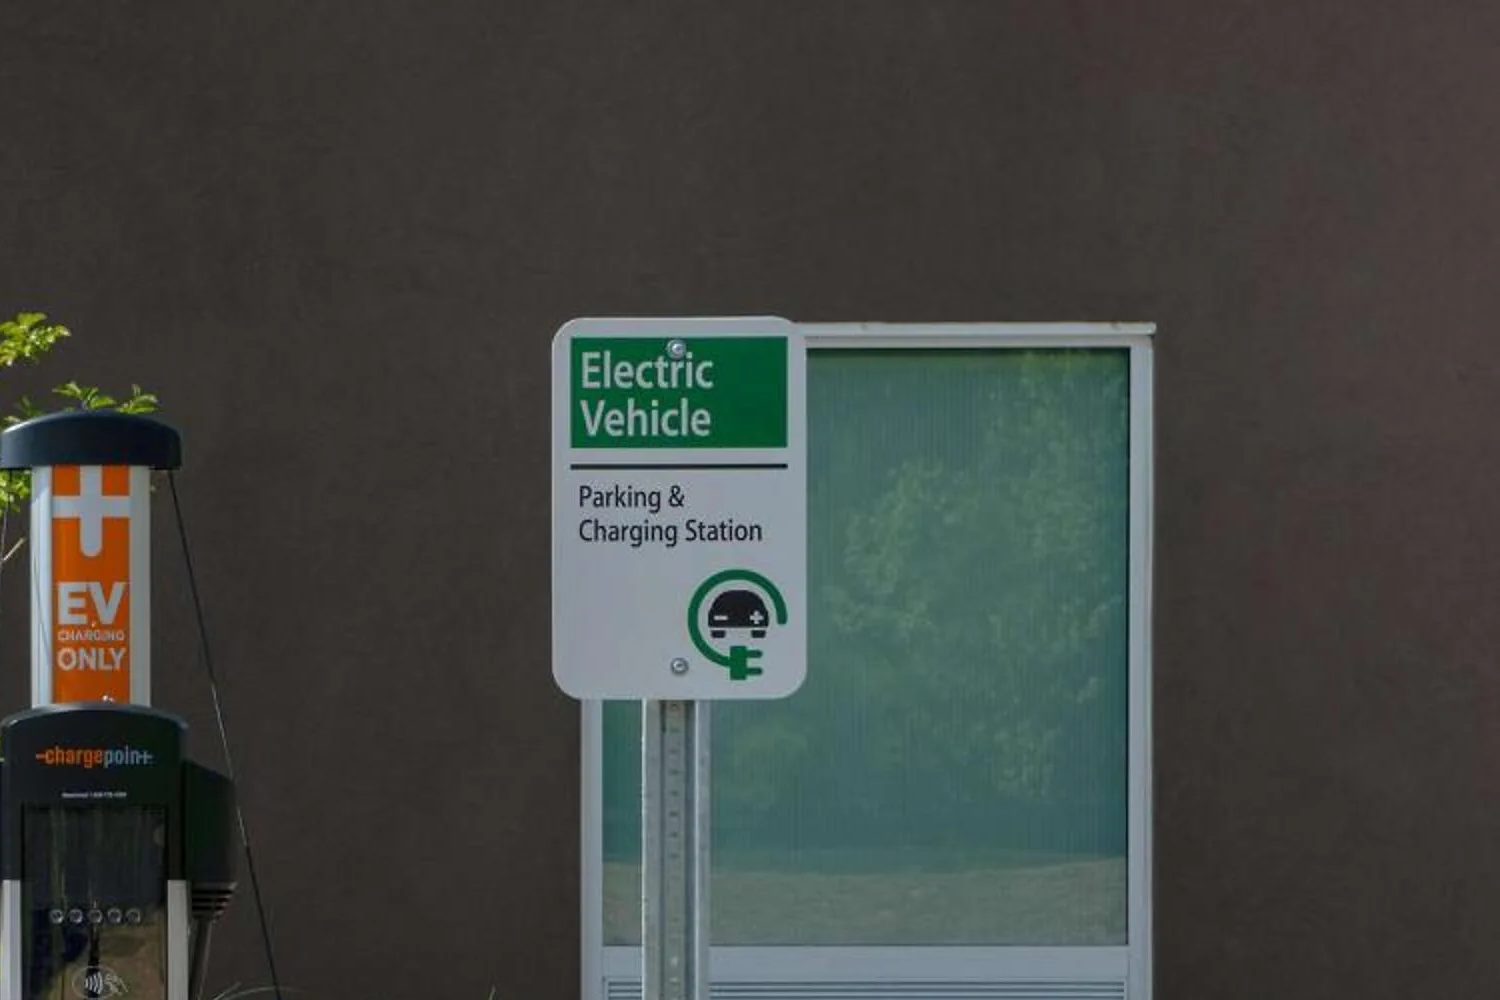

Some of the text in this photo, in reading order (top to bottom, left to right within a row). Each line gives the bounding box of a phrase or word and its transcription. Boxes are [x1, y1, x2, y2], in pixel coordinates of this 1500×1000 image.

[580, 350, 714, 390] Electric
[580, 398, 712, 437] Vehicle
[578, 484, 685, 514] Parking &
[578, 519, 763, 548] Charging Station
[57, 581, 127, 626] EV
[57, 629, 126, 642] CHARGING
[56, 647, 127, 671] ONLY
